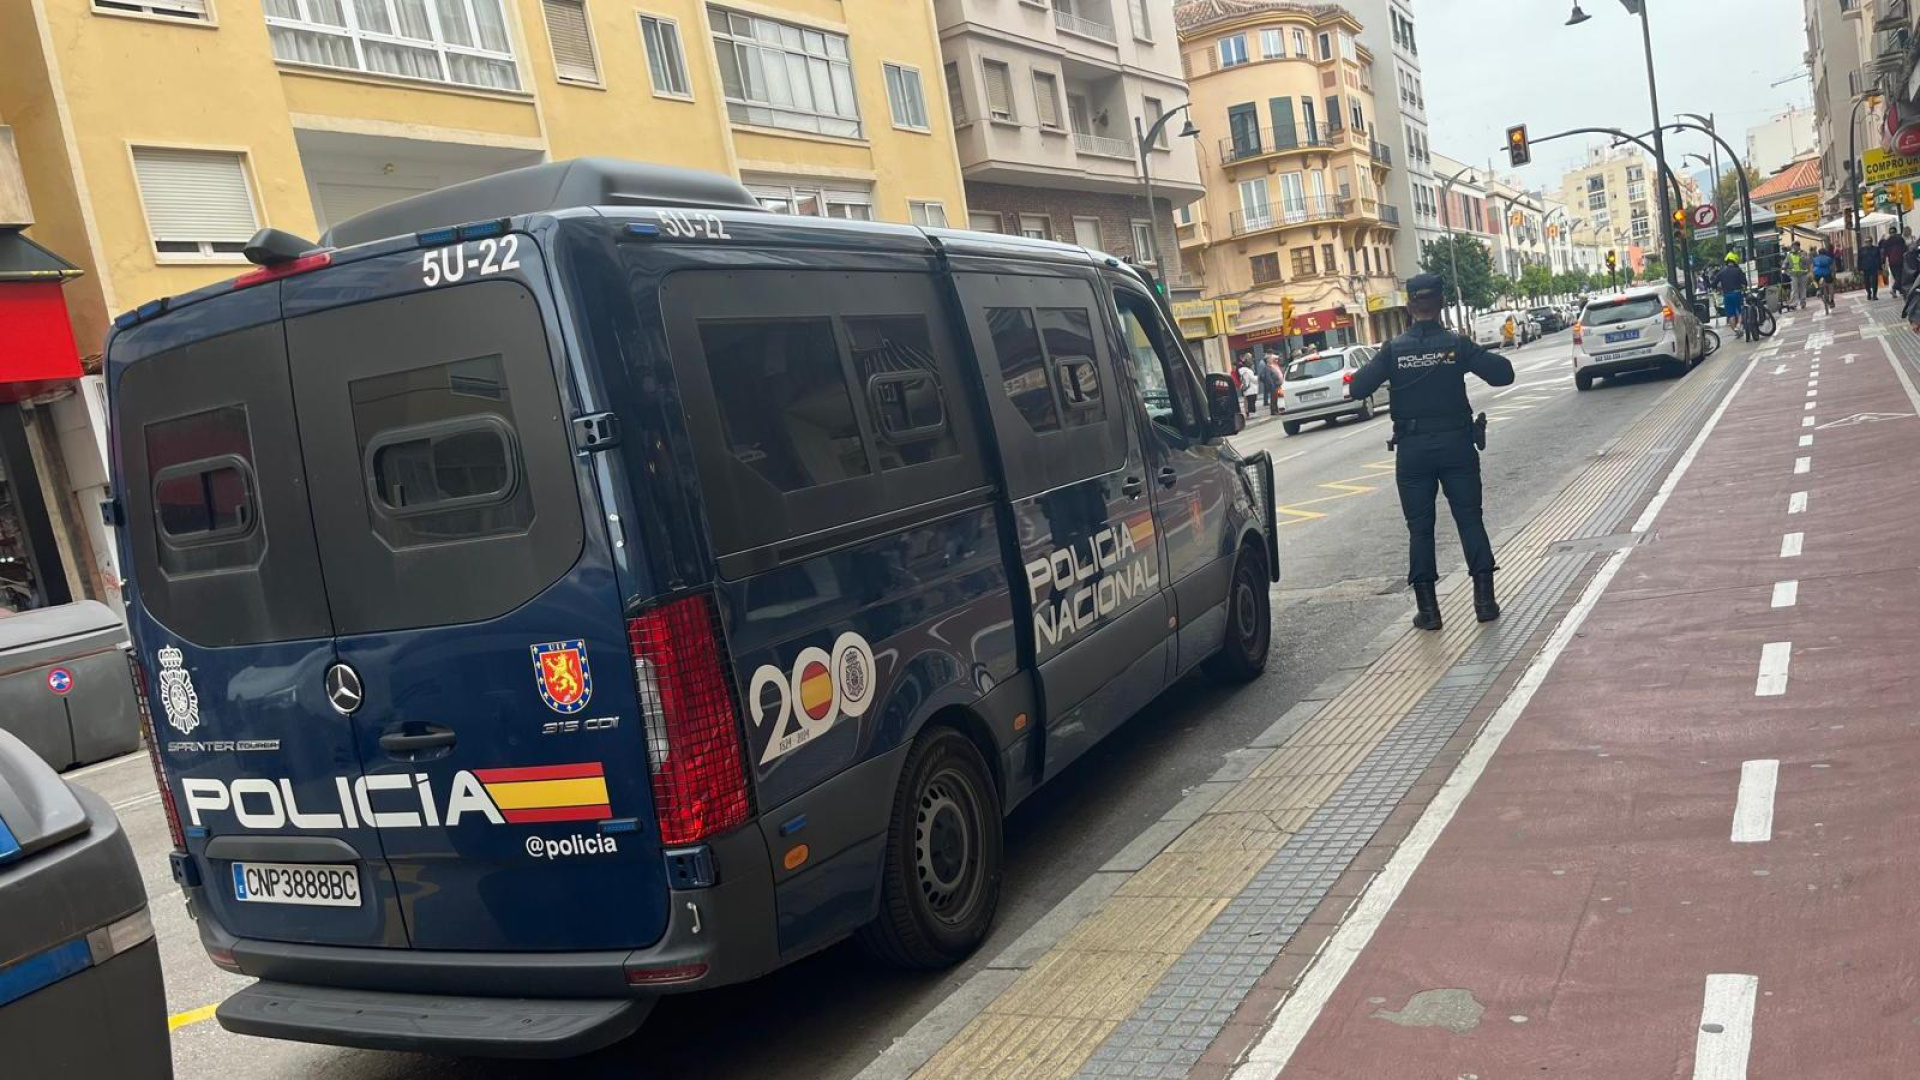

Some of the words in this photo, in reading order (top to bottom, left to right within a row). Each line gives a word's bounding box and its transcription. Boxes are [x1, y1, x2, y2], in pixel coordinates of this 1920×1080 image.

[1866, 158, 1904, 174] COMPRO
[657, 210, 732, 240] 5U-22
[422, 234, 520, 288] 5U-22
[1034, 557, 1159, 653] NACIONAL
[548, 642, 567, 650] UIP
[749, 630, 877, 766] 200
[542, 720, 580, 734] 315
[584, 715, 620, 730] CDI
[167, 740, 235, 752] SPRINTER
[237, 740, 278, 751] TOURER
[525, 832, 619, 860] @policia
[246, 868, 357, 900] CNP3888BC
